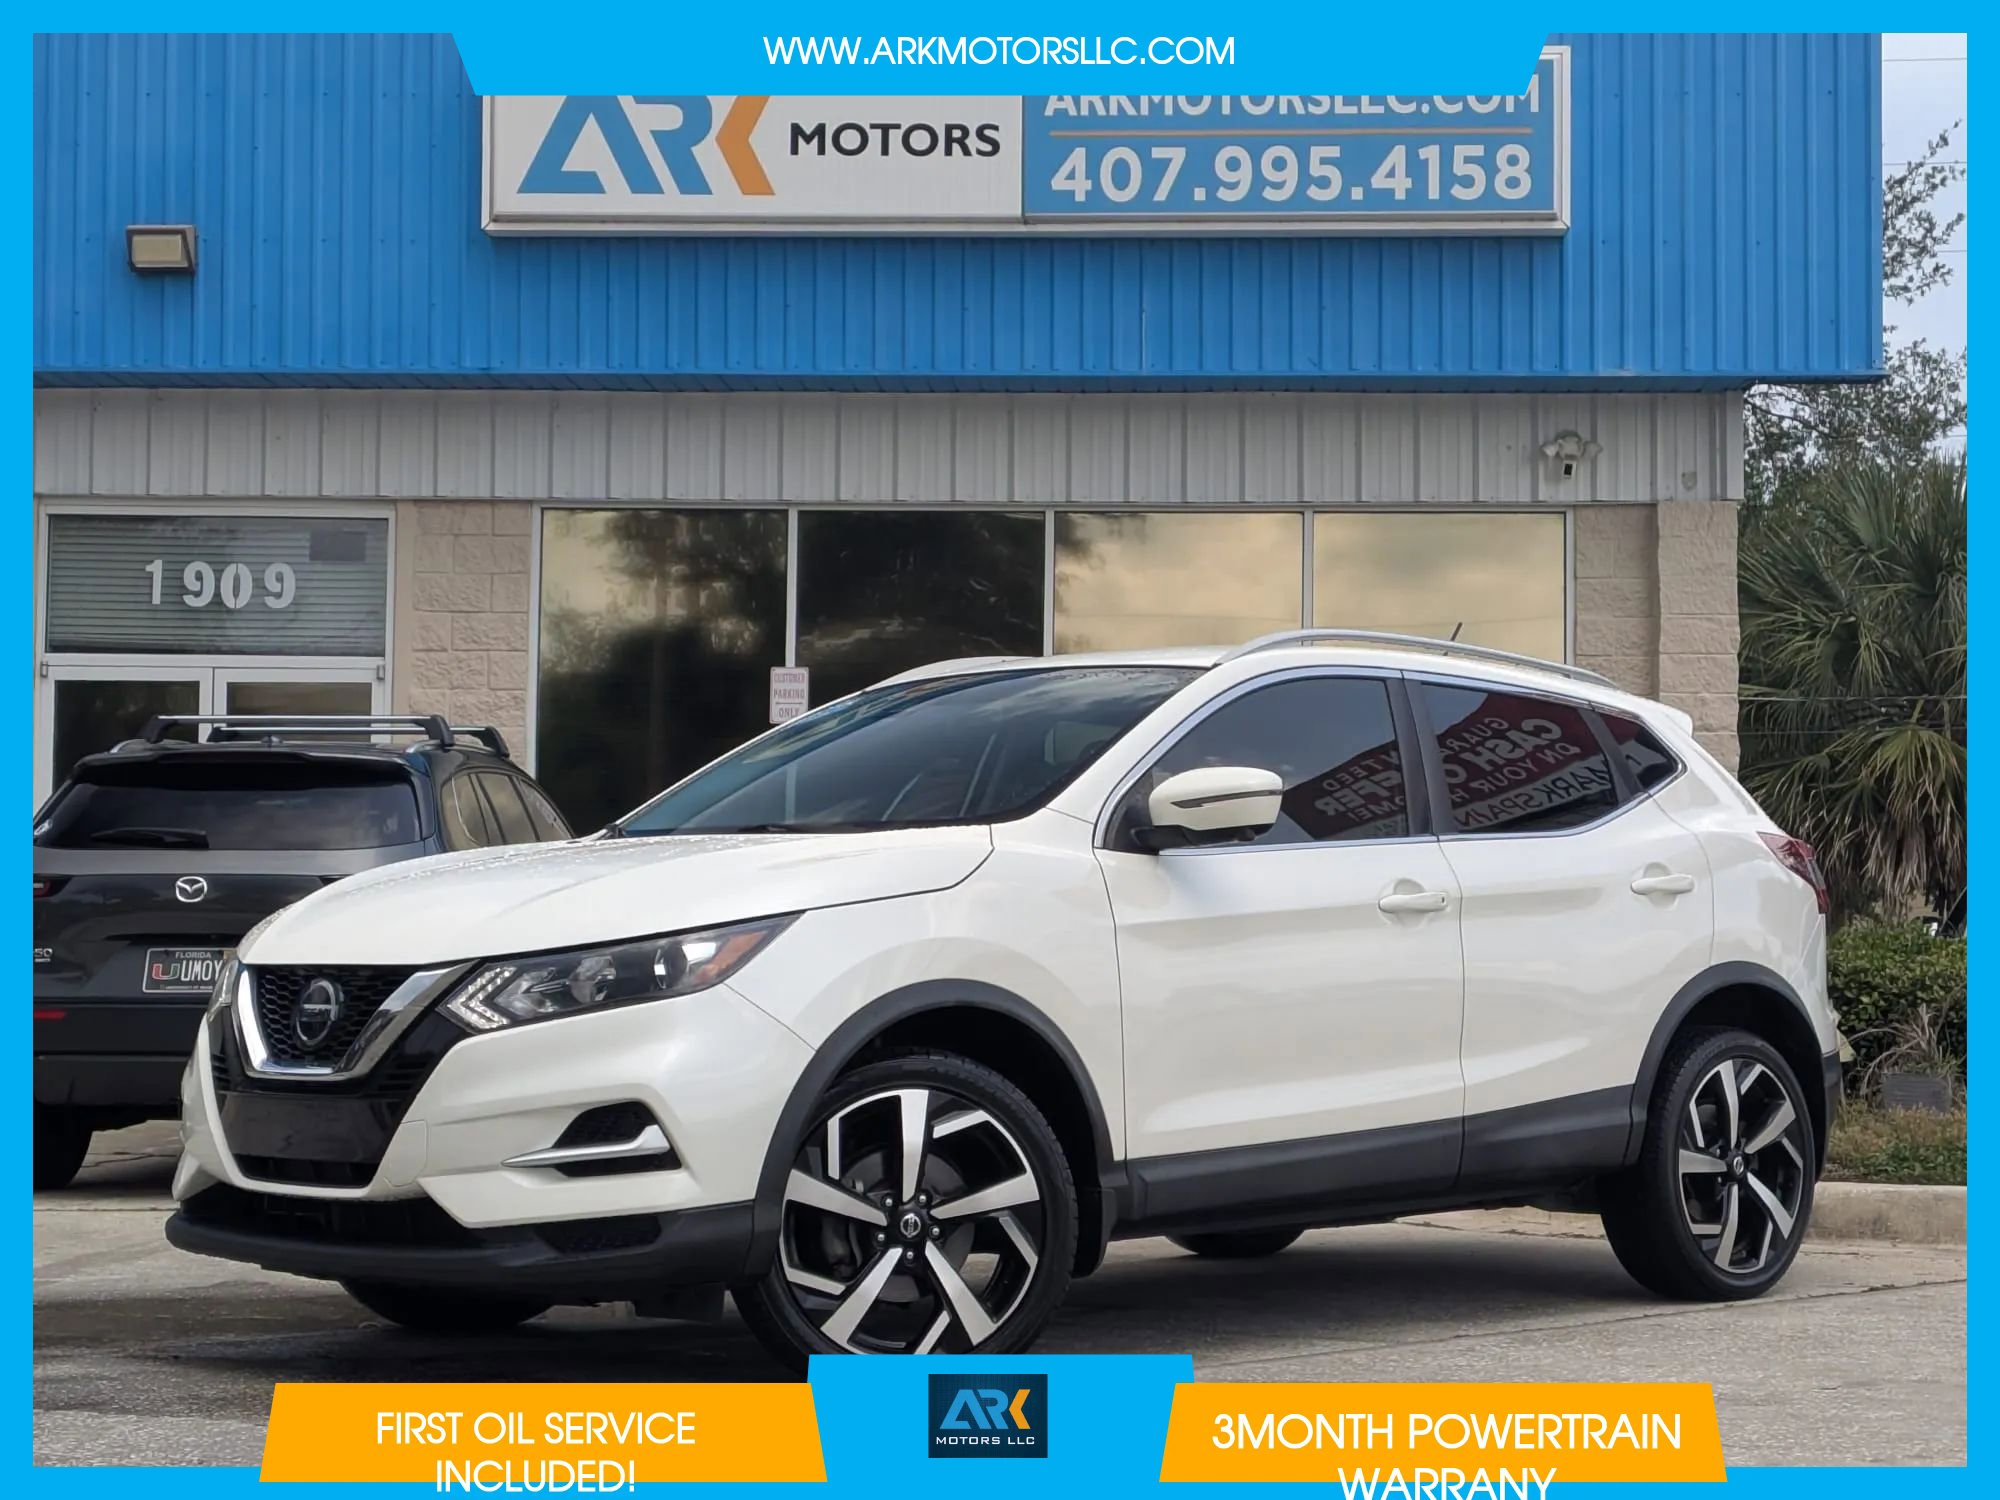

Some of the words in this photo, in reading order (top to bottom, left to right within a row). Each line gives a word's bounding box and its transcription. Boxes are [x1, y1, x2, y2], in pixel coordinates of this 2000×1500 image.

[516, 95, 775, 196] ARK
[789, 122, 1001, 158] MOTORS
[1050, 143, 1532, 203] 407.995.4158
[145, 559, 296, 609] 1909
[773, 688, 806, 700] PARKING
[778, 707, 800, 719] ONLY
[175, 951, 212, 959] FLORIDA
